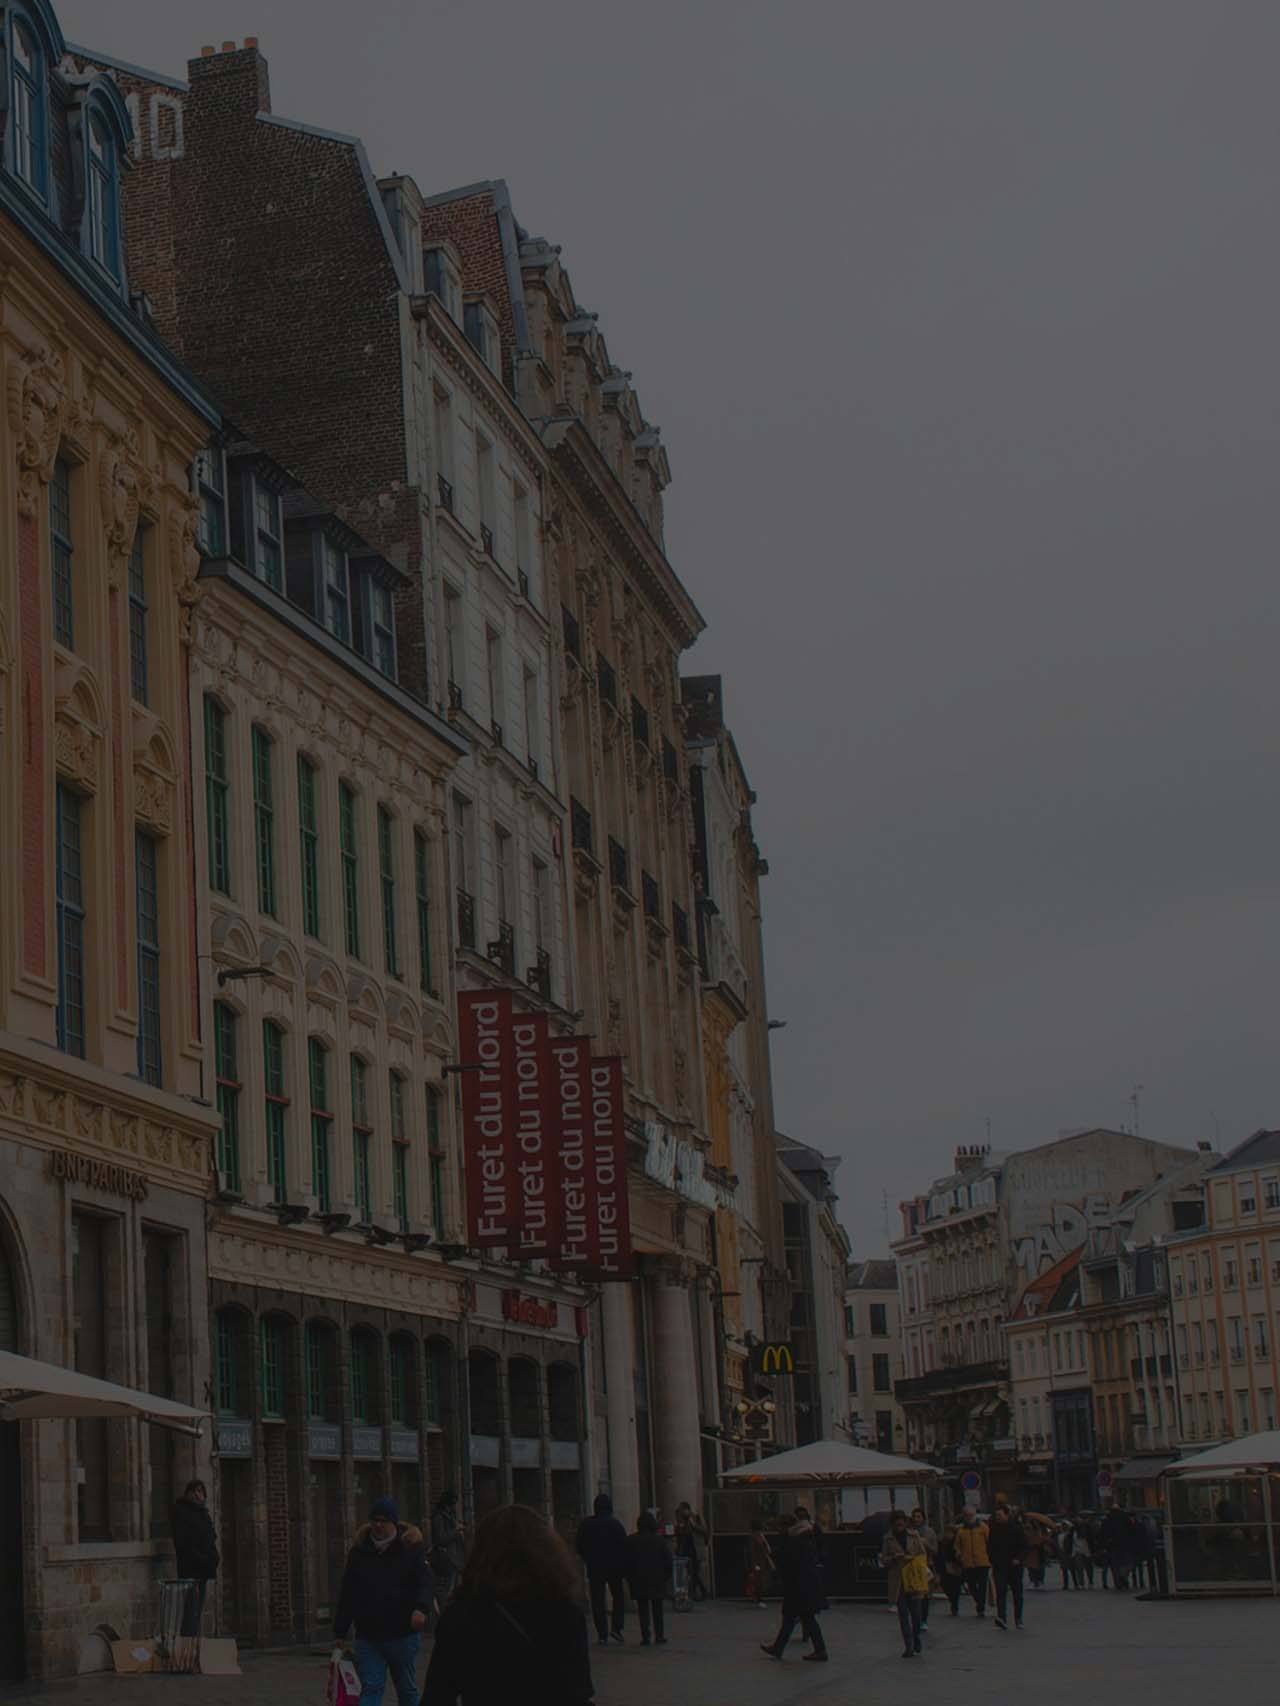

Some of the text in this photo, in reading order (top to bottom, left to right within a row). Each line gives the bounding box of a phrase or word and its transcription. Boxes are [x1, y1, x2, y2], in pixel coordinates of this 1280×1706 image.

[50, 1151, 147, 1201] BNP PARIBAS
[470, 1001, 508, 1237] Furet du nord
[513, 1024, 547, 1248] Furet du nord
[553, 1047, 588, 1262] Furet du nord
